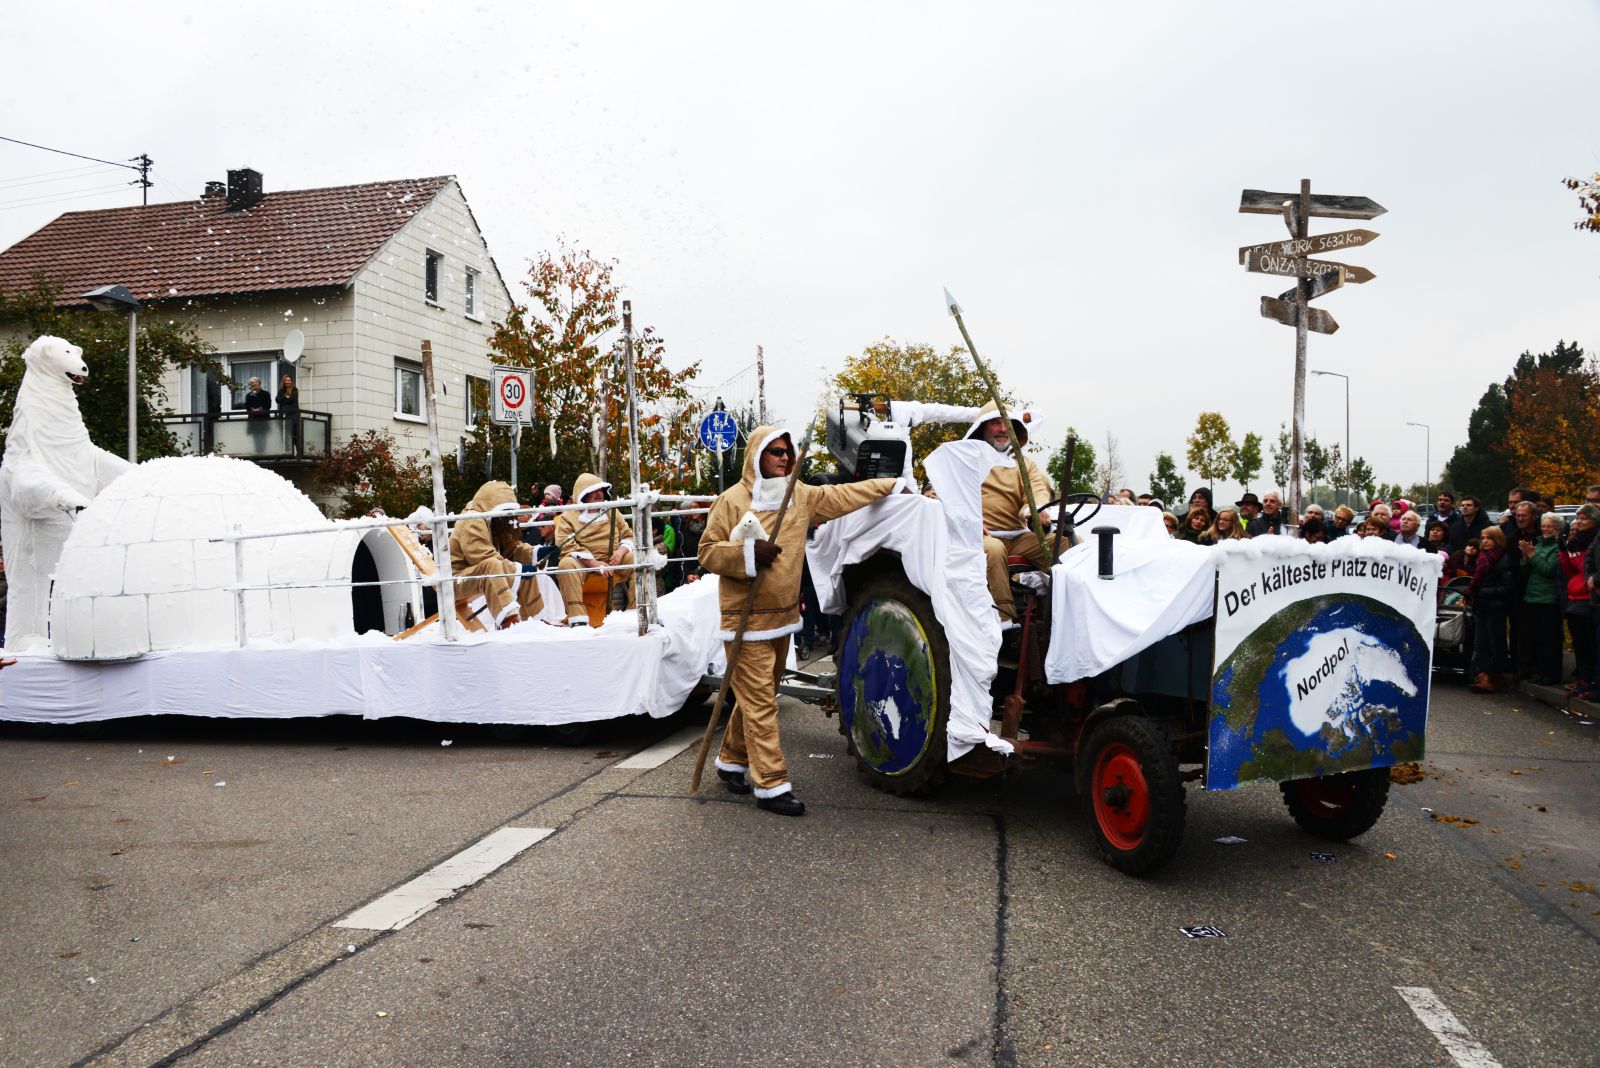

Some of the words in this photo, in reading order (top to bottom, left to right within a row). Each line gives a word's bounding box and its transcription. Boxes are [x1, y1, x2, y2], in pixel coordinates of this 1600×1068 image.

[1319, 234, 1345, 250] 5632
[1260, 255, 1296, 274] ONZA
[505, 383, 521, 399] 30
[504, 410, 523, 420] ZONE
[1224, 582, 1257, 617] Der
[1261, 559, 1326, 595] kälteste
[1331, 558, 1367, 577] Platz
[1371, 561, 1394, 581] der
[1397, 563, 1428, 601] Welt
[1296, 638, 1350, 701] Nordpol
